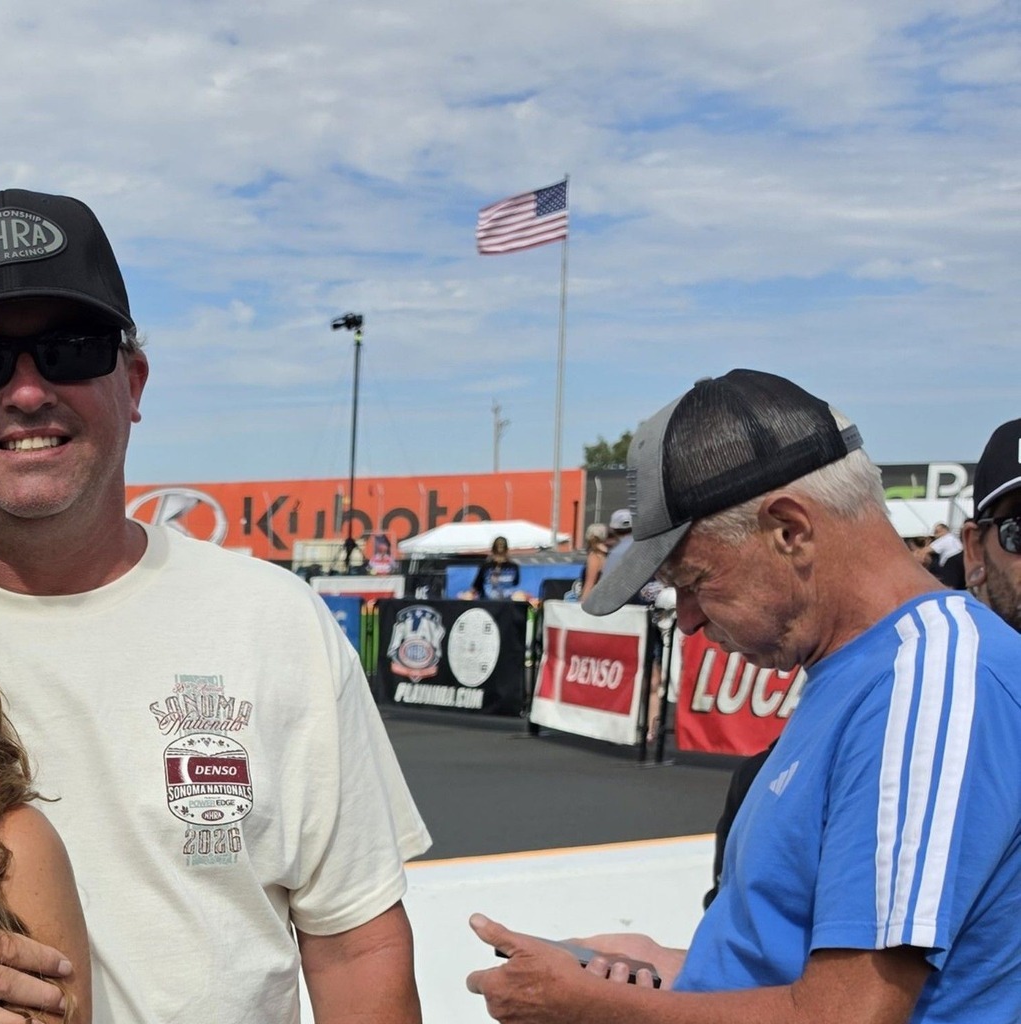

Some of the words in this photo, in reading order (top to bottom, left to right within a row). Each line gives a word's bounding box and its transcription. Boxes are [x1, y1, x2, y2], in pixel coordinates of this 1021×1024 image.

[4, 246, 45, 259] RACING
[566, 655, 624, 690] DENSO
[195, 765, 238, 776] DENSO
[168, 785, 206, 800] SONOMA
[207, 784, 253, 801] NATIONALS
[204, 811, 223, 820] NHRA
[183, 827, 242, 855] 2026
